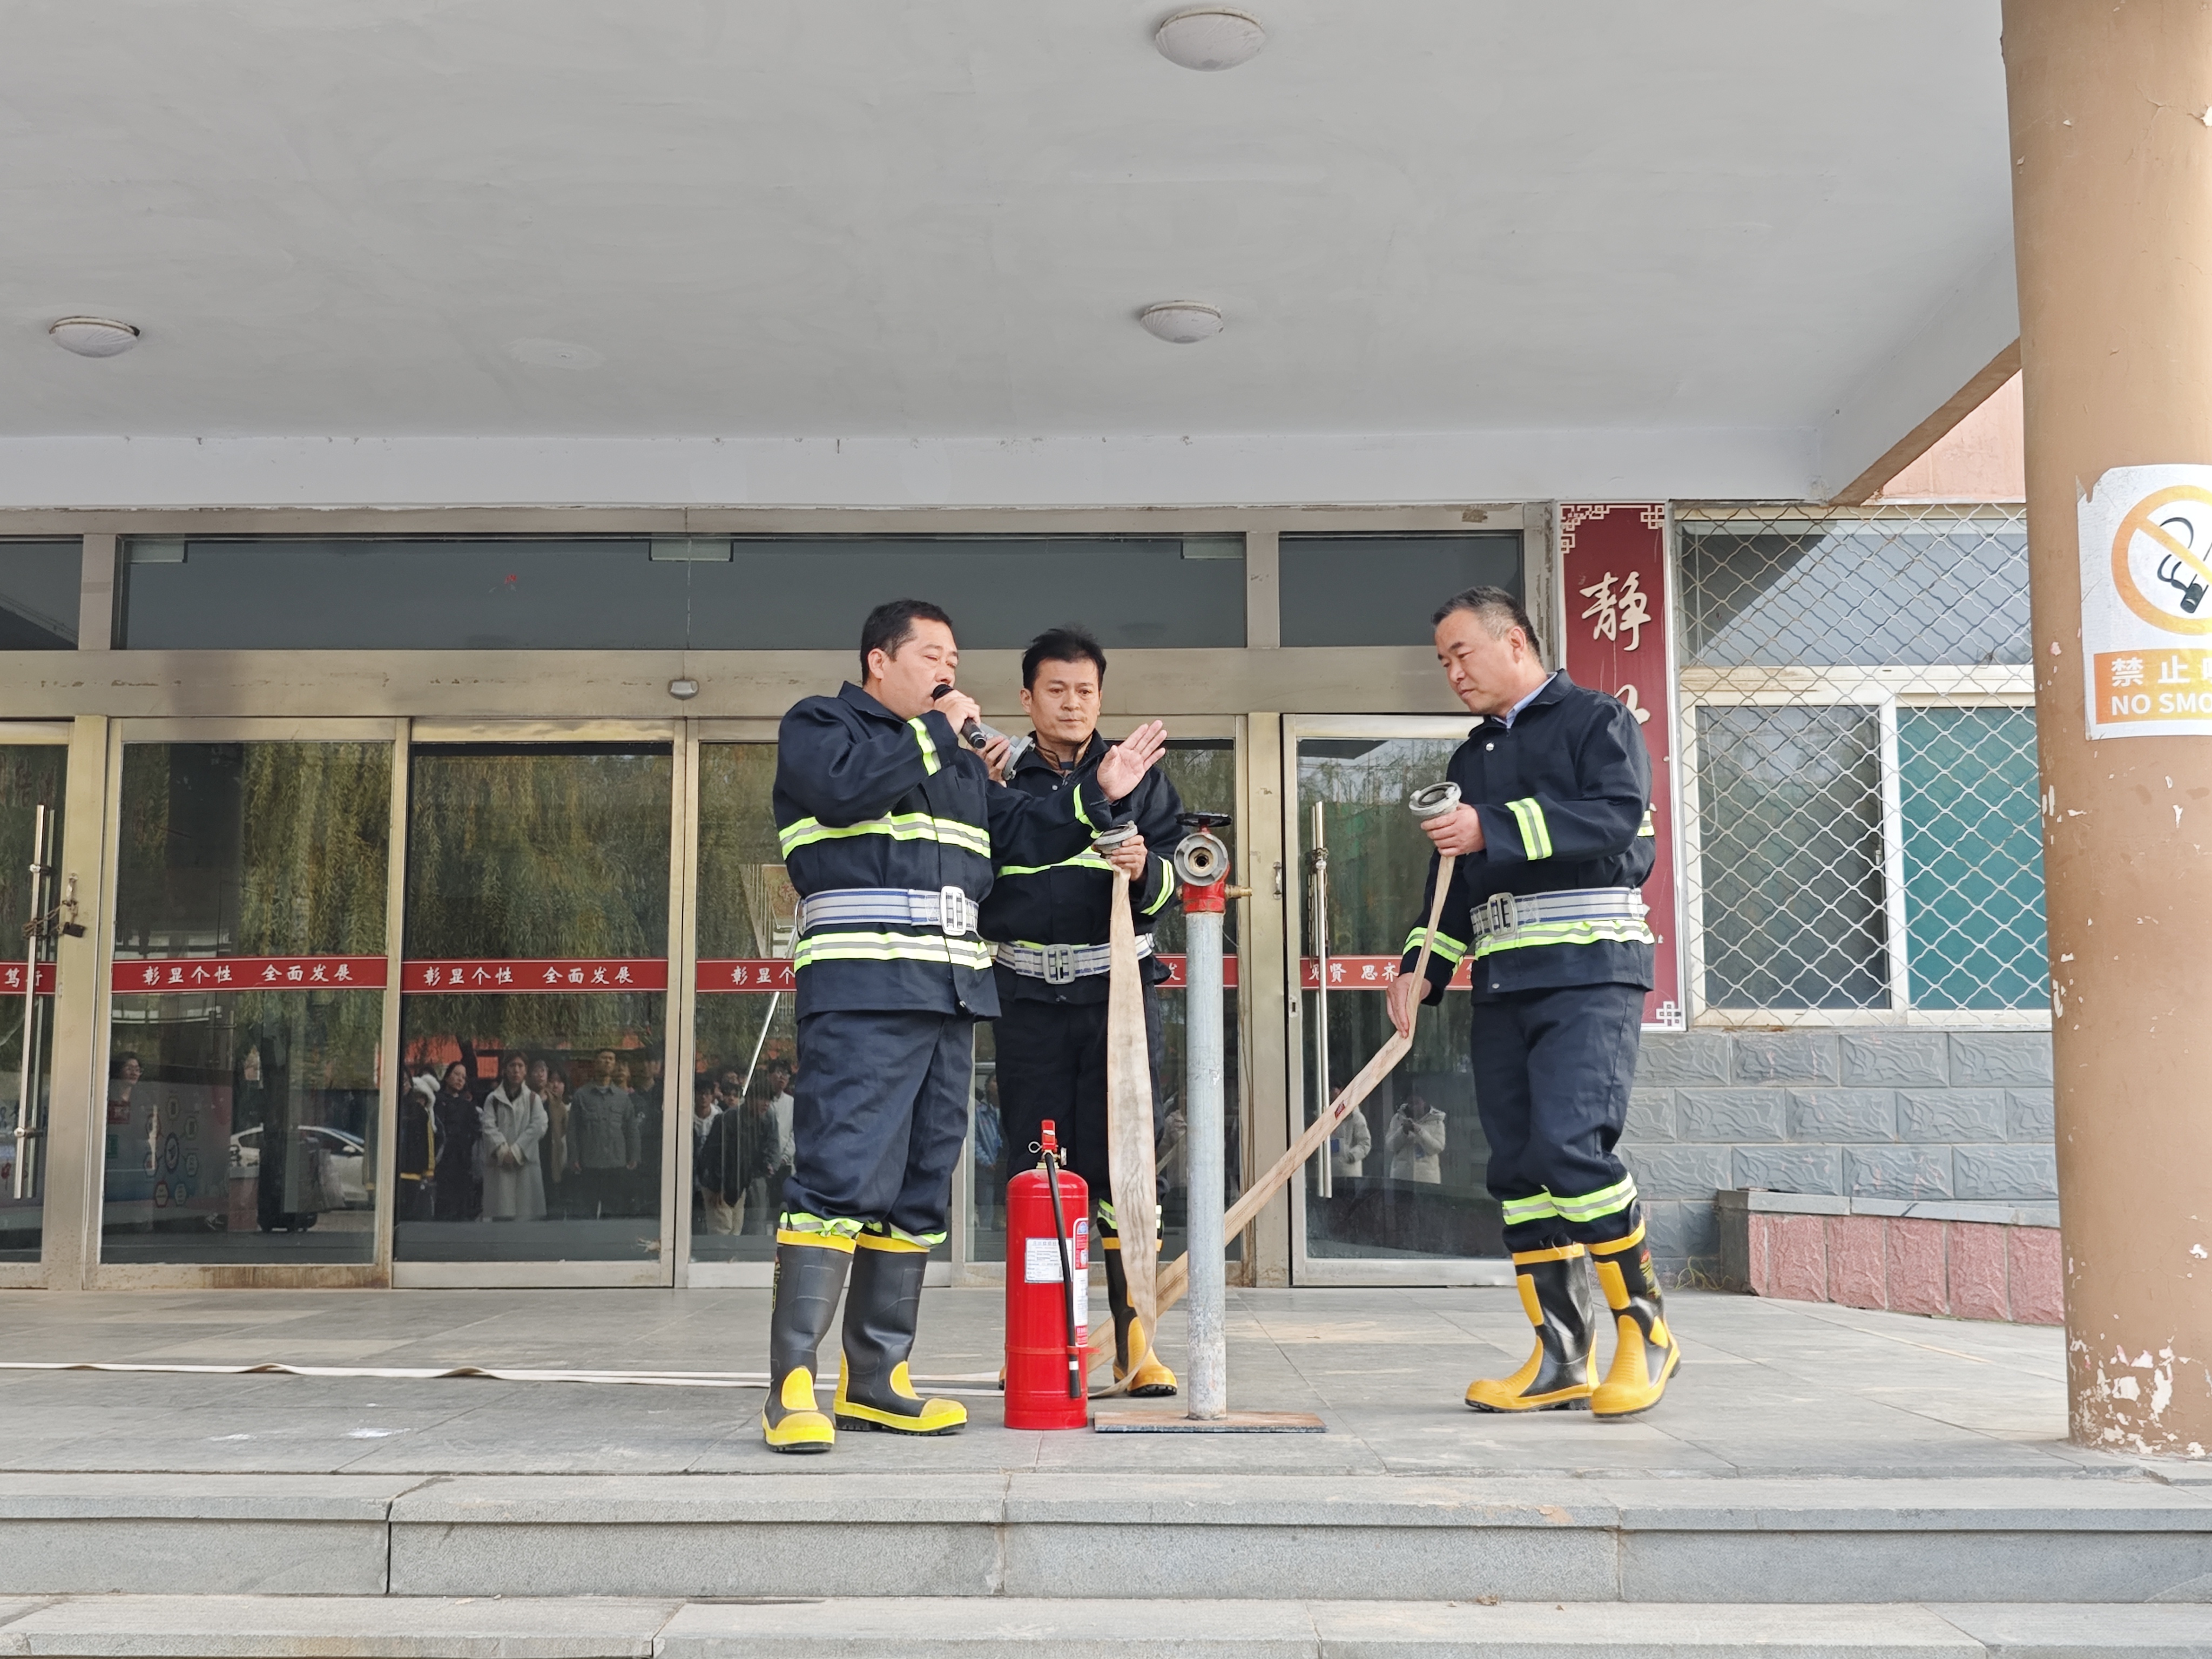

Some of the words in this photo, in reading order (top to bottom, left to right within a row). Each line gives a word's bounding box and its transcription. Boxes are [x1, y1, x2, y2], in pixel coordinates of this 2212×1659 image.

[2111, 694, 2152, 716] NO
[2159, 692, 2212, 714] SMO
[143, 965, 233, 985] 彰显个性
[261, 963, 353, 982] 全面发展
[423, 966, 514, 986] 彰显个性
[542, 966, 633, 984] 全面发展
[731, 965, 795, 985] 彰显个
[1361, 962, 1399, 983] 思齐
